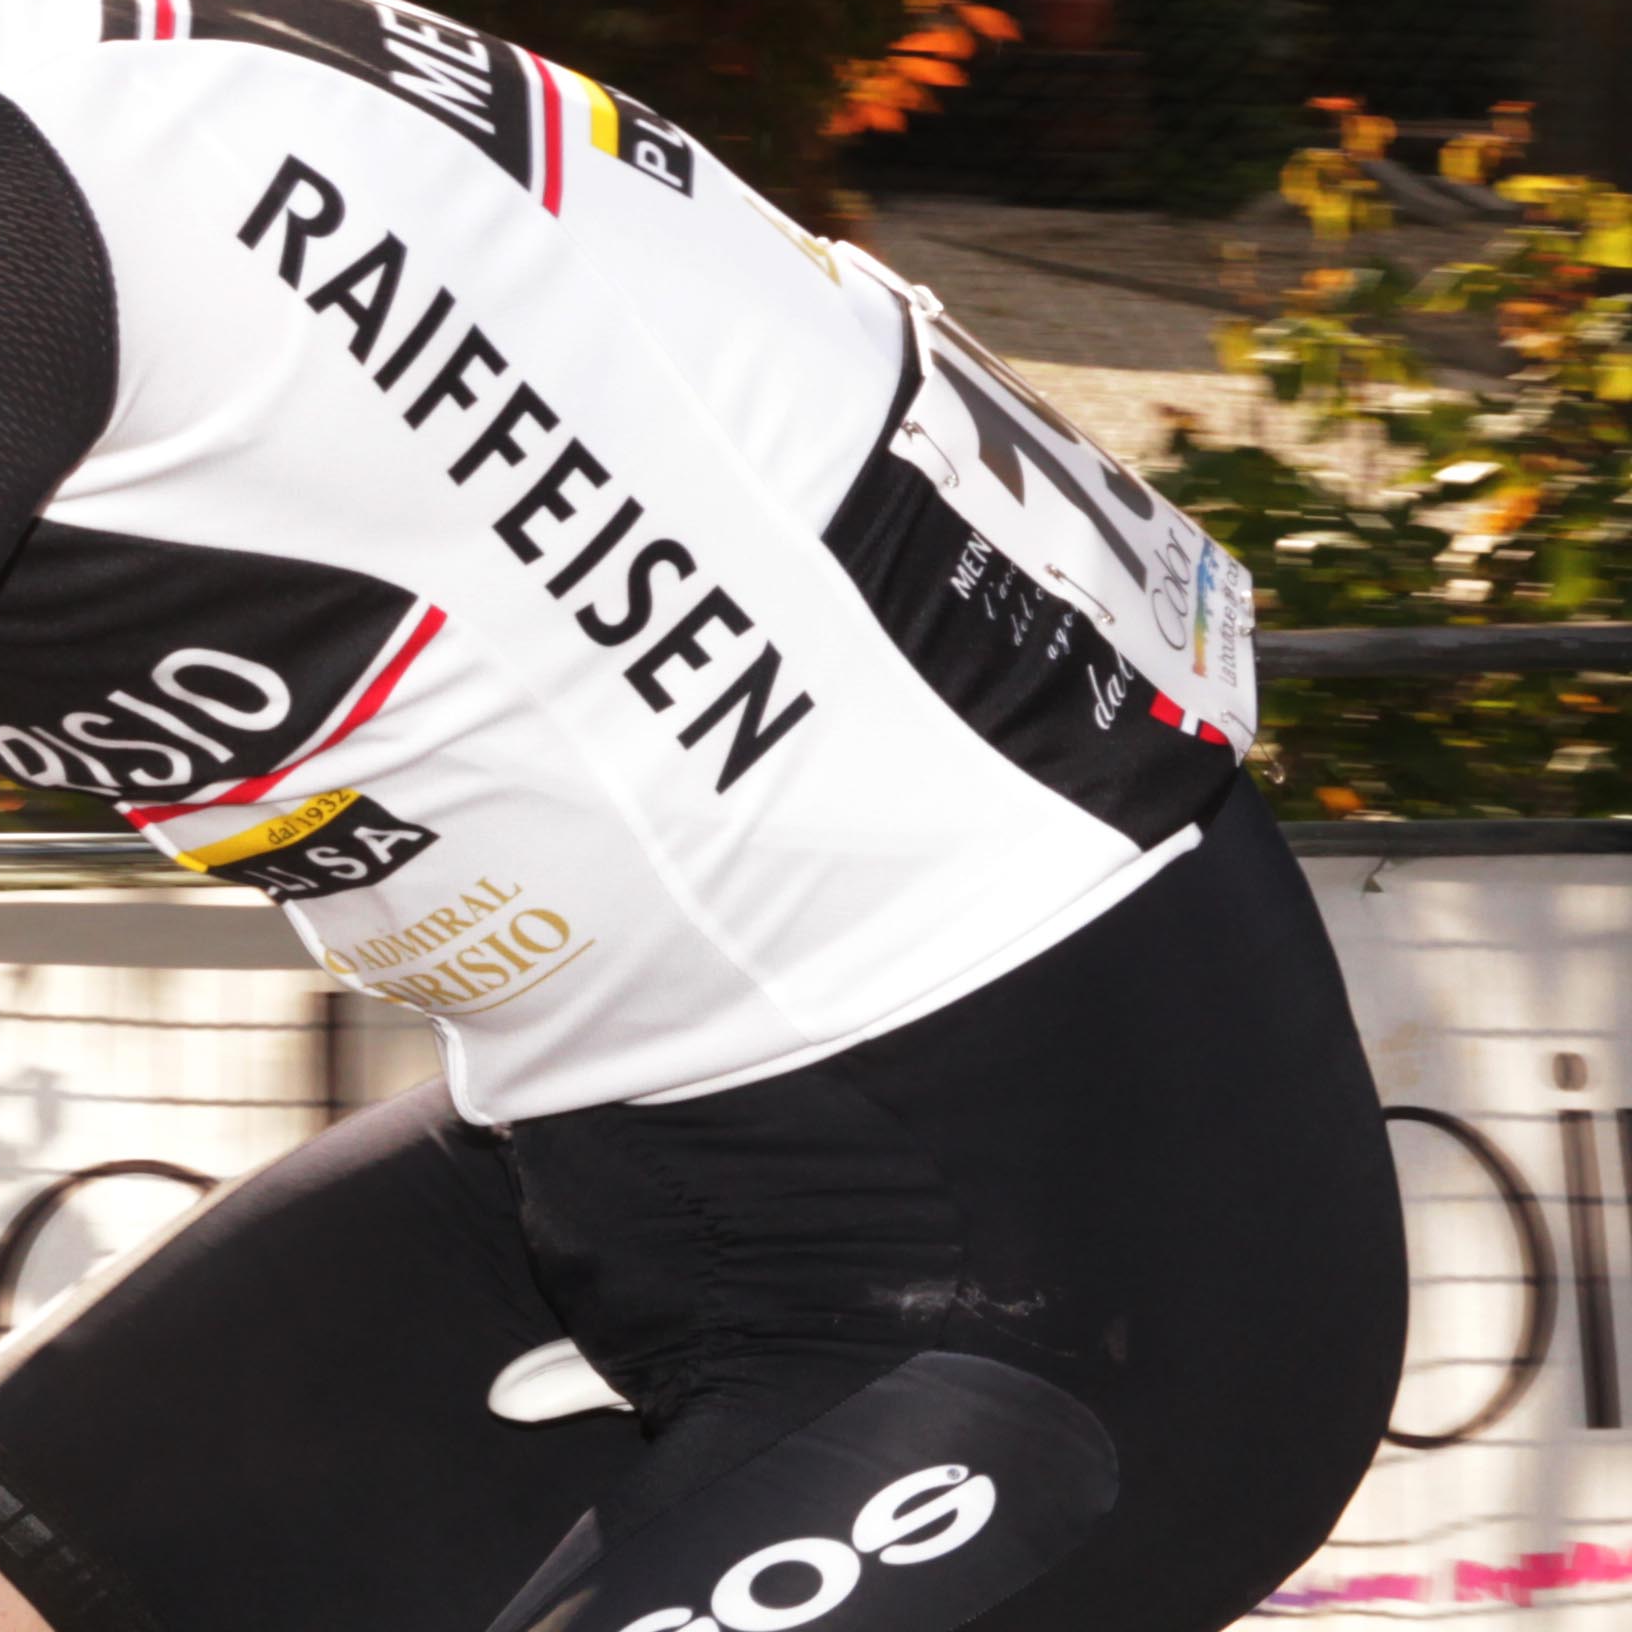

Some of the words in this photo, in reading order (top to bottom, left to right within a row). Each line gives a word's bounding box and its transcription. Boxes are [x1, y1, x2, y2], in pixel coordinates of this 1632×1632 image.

[236, 154, 815, 795] RAIFFEISEN
[950, 531, 993, 599] MEN
[267, 820, 298, 847] dal
[296, 788, 351, 829] 1932
[305, 826, 424, 880] SA
[353, 875, 524, 969] ADMIRAL
[363, 907, 571, 1009] DRISIO
